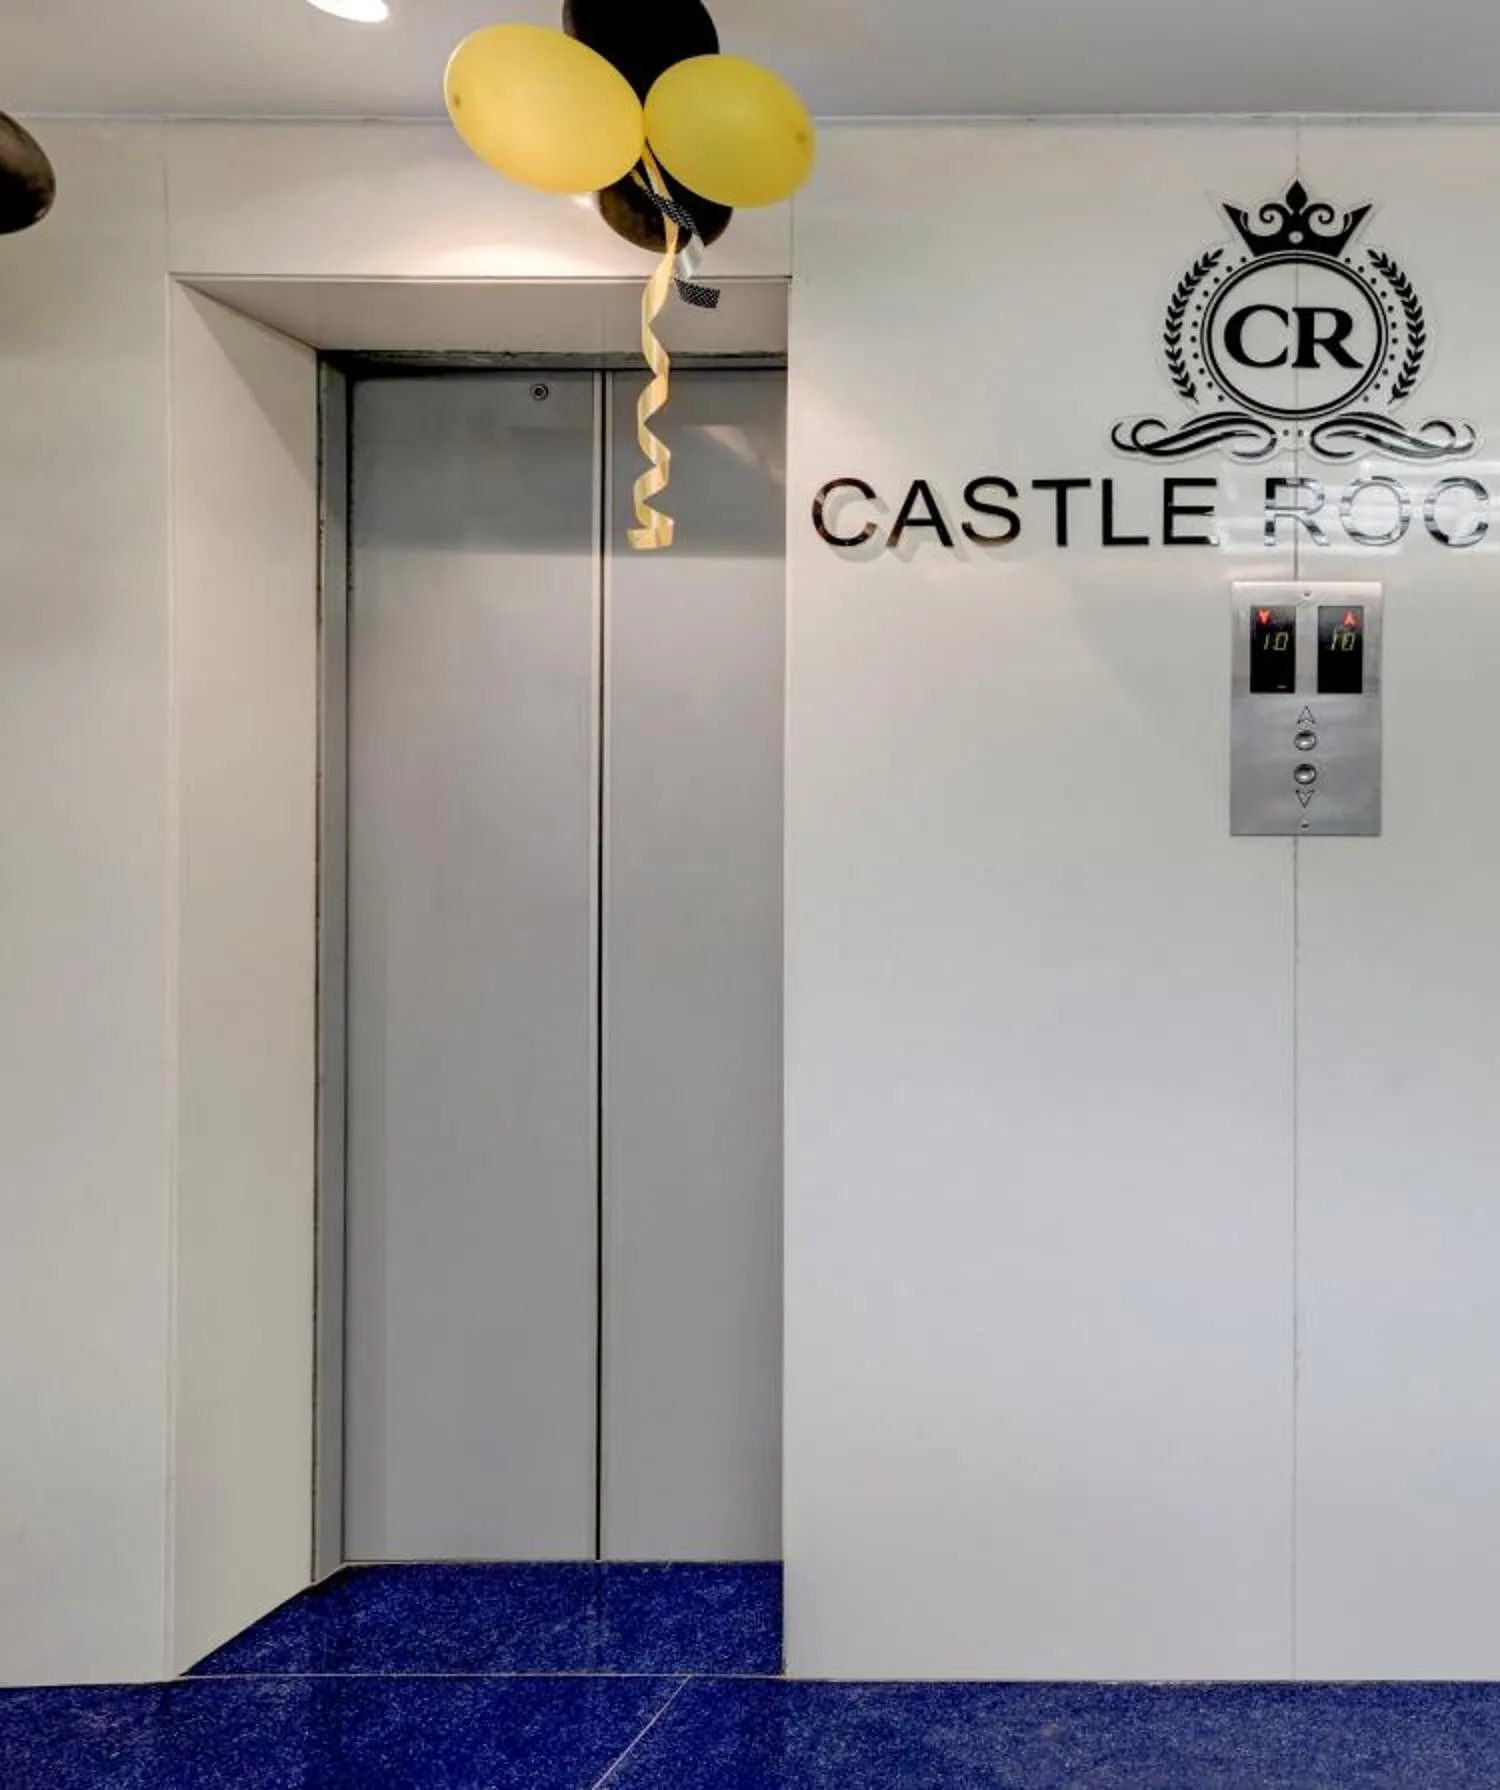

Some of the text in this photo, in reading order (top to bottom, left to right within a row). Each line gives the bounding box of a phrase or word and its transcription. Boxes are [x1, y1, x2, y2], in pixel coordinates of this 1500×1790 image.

[1223, 304, 1364, 369] CR
[811, 476, 1220, 548] CASTLE
[1263, 632, 1289, 651] 10
